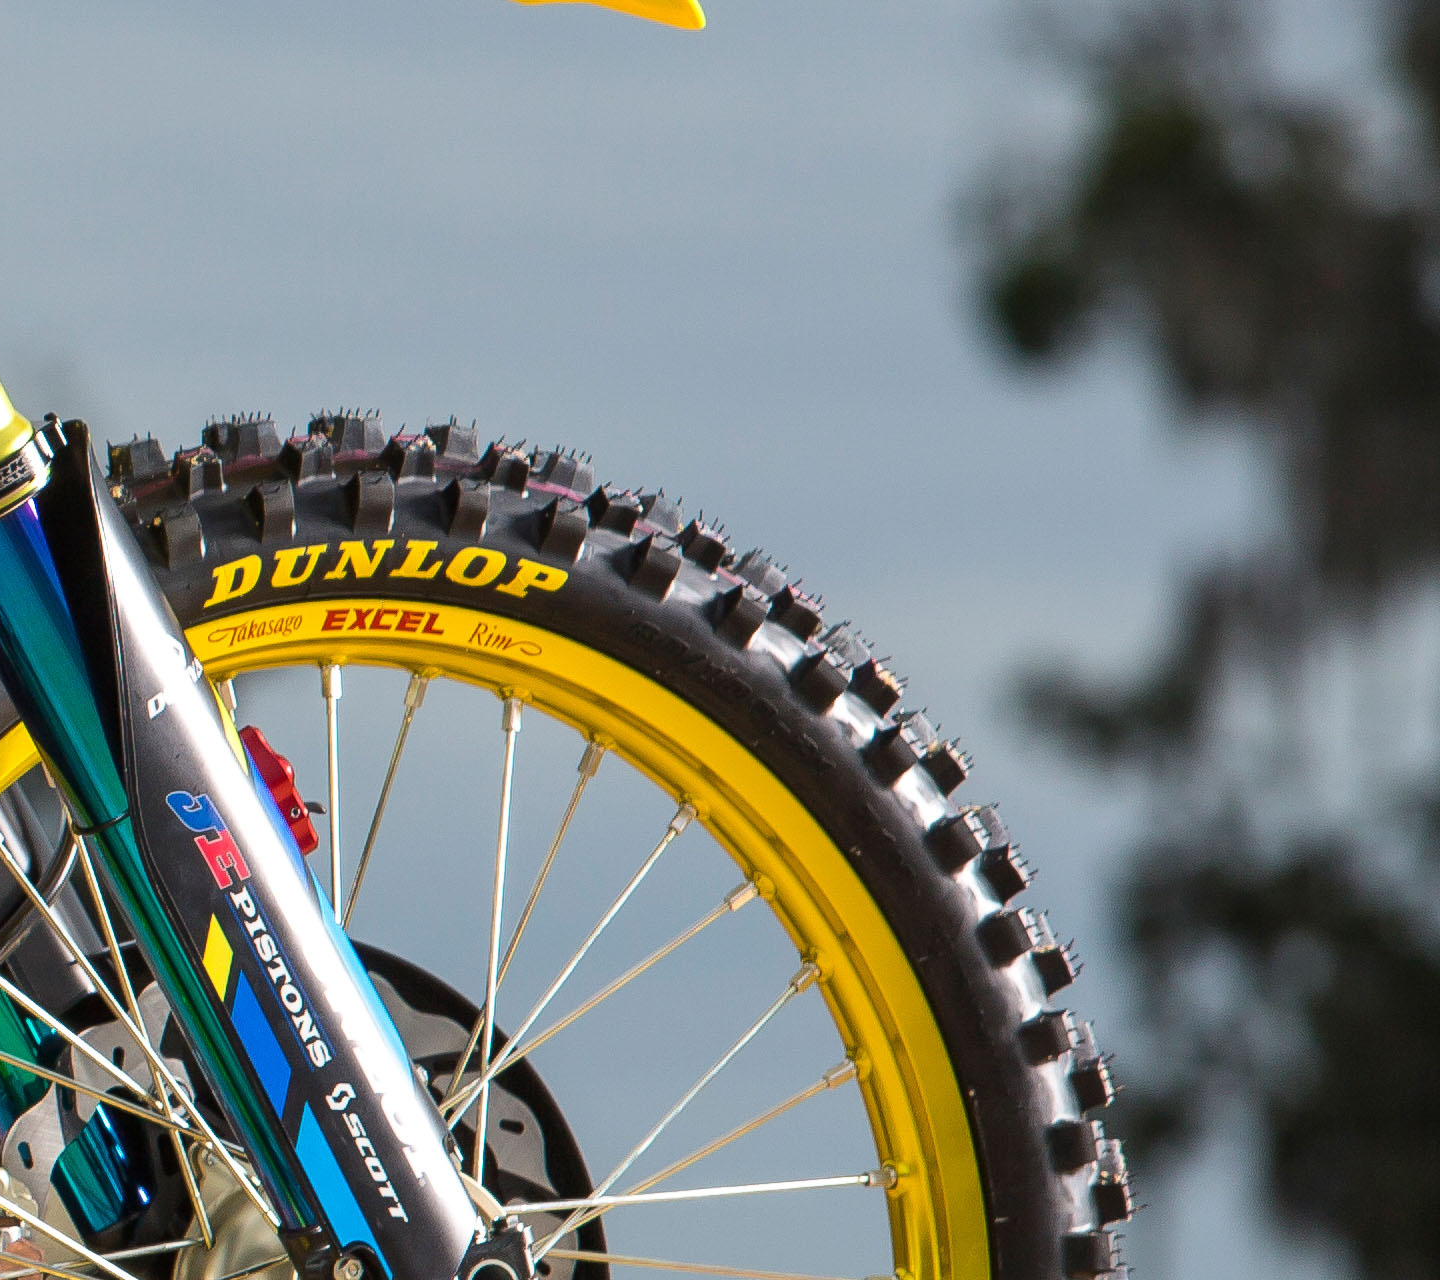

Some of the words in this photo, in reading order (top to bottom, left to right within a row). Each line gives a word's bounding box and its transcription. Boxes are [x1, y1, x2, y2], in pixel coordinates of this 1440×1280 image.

[204, 538, 569, 609] DUNLOP
[208, 613, 304, 648] Takasago
[321, 608, 445, 635] EXCEL
[468, 621, 544, 657] Rim
[166, 789, 255, 890] JE
[227, 891, 333, 1071] PISTONS
[342, 1112, 409, 1224] SCOTT
